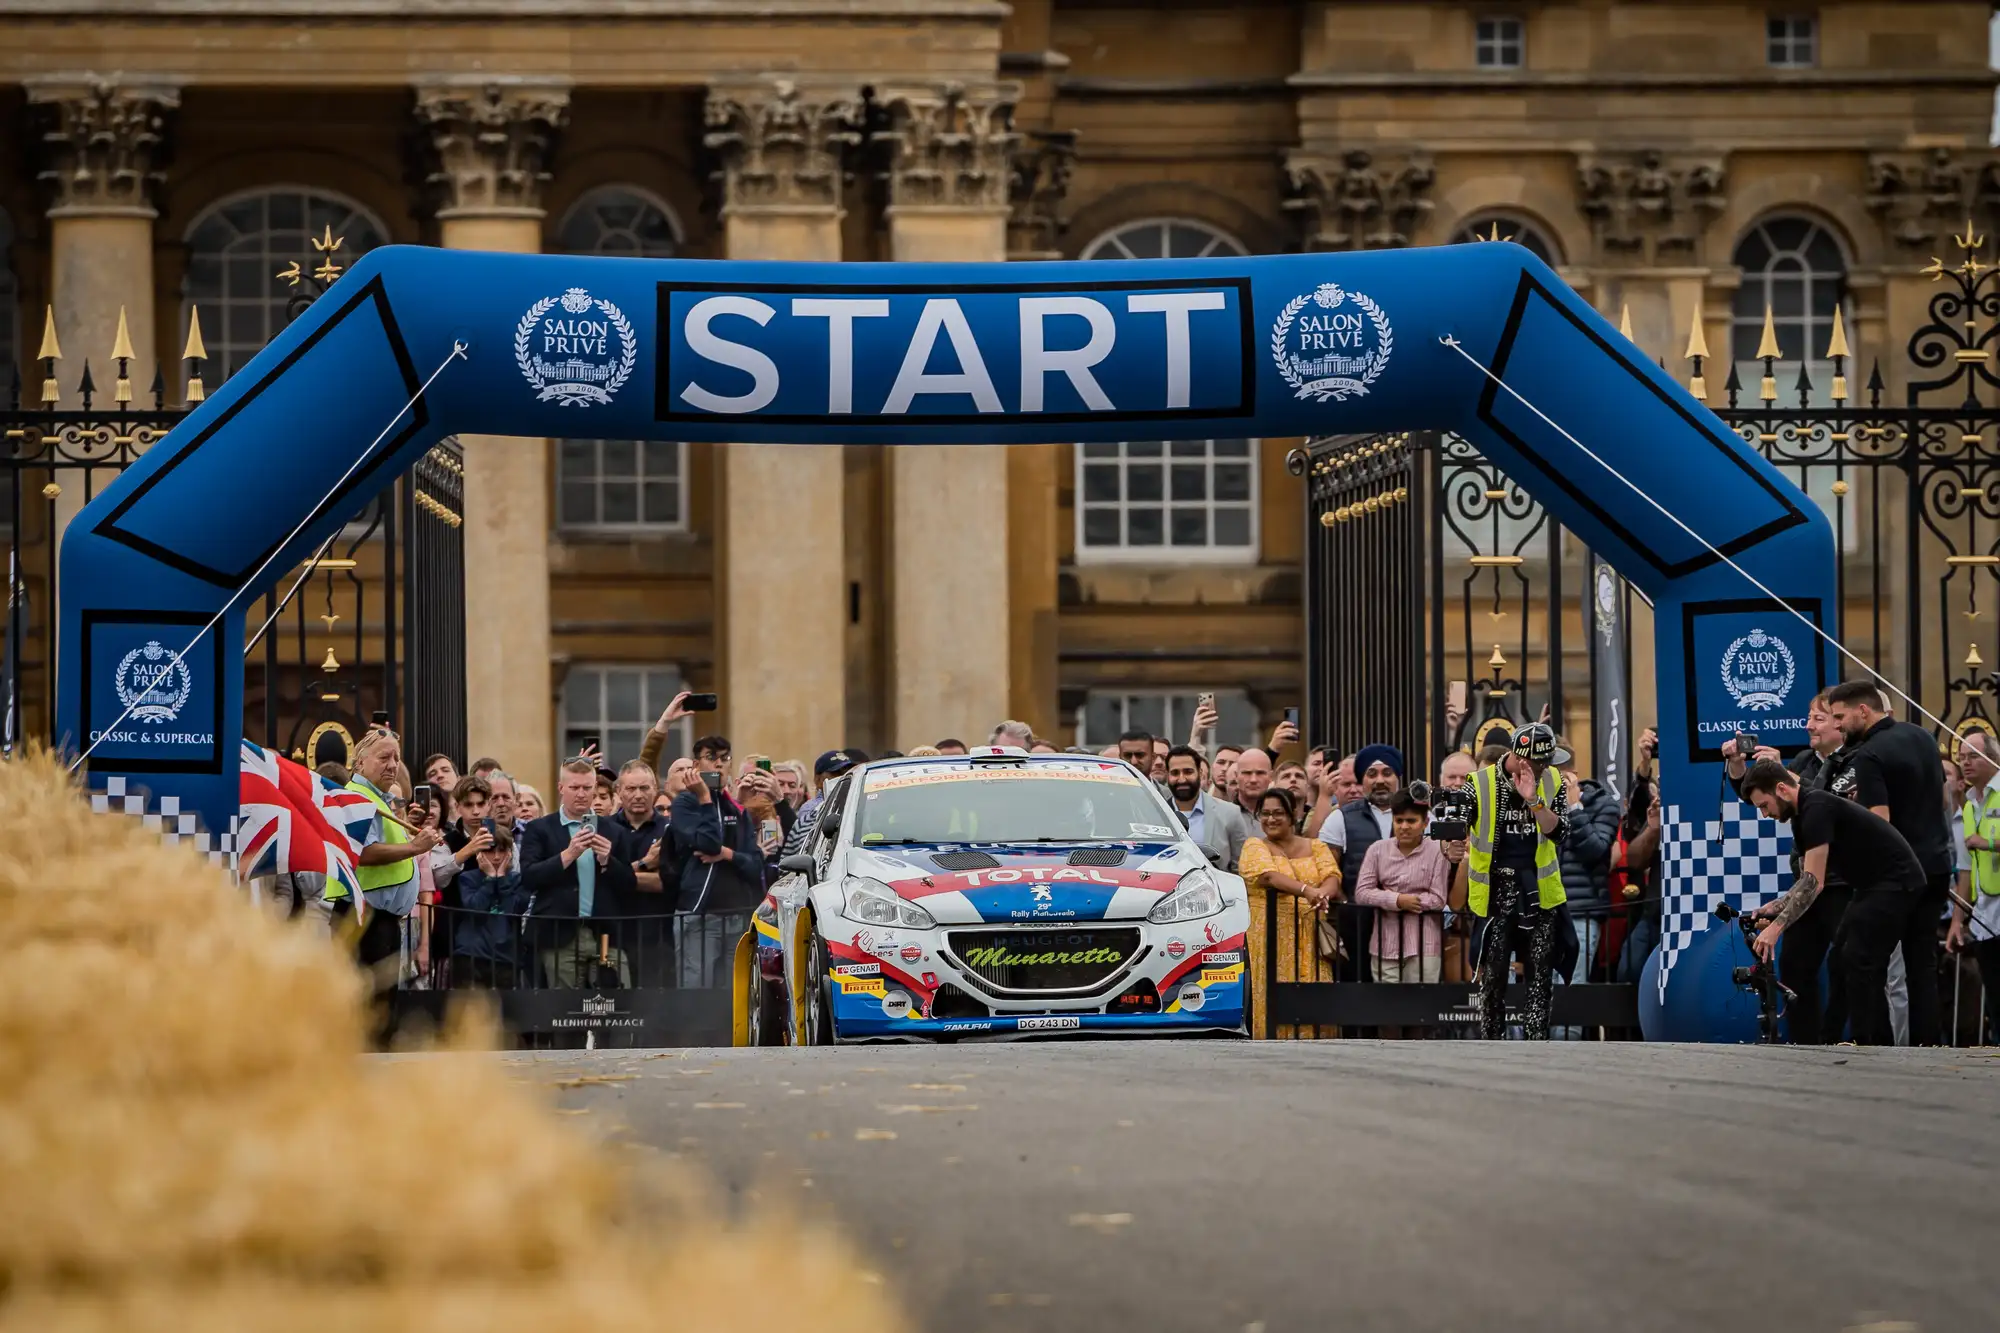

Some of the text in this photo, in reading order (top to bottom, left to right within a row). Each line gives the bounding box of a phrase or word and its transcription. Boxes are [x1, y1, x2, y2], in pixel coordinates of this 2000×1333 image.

[543, 318, 608, 338] SALON
[1300, 313, 1363, 333] SALON
[543, 336, 607, 356] PRIVÉ
[1300, 328, 1364, 351] PRIVÉ
[680, 291, 1226, 415] START
[552, 384, 598, 395] EST. 2006
[1310, 379, 1355, 390] EST. 2006
[1738, 651, 1778, 664] SALON
[132, 663, 174, 677] SALON
[1697, 718, 1808, 733] CLASSIC & SUPERC
[89, 730, 215, 744] CLASSIC & SUPERCAR
[873, 773, 969, 788] SALTFORD
[974, 770, 1038, 779] MOTOR
[1044, 771, 1131, 783] SERVICES
[1151, 826, 1169, 835] 23
[954, 867, 1119, 886] TOTAL
[1011, 910, 1030, 919] Rally
[993, 934, 1096, 948] PEUGEOT
[965, 946, 1123, 967] Munaretto
[1213, 953, 1239, 961] GENART
[850, 964, 879, 973] GENART
[1204, 971, 1236, 981] PIRELLI
[844, 981, 881, 992] PIRELLI
[551, 1018, 645, 1028] BLENHEIM PALACE
[1019, 1018, 1078, 1029] DG 243 DN
